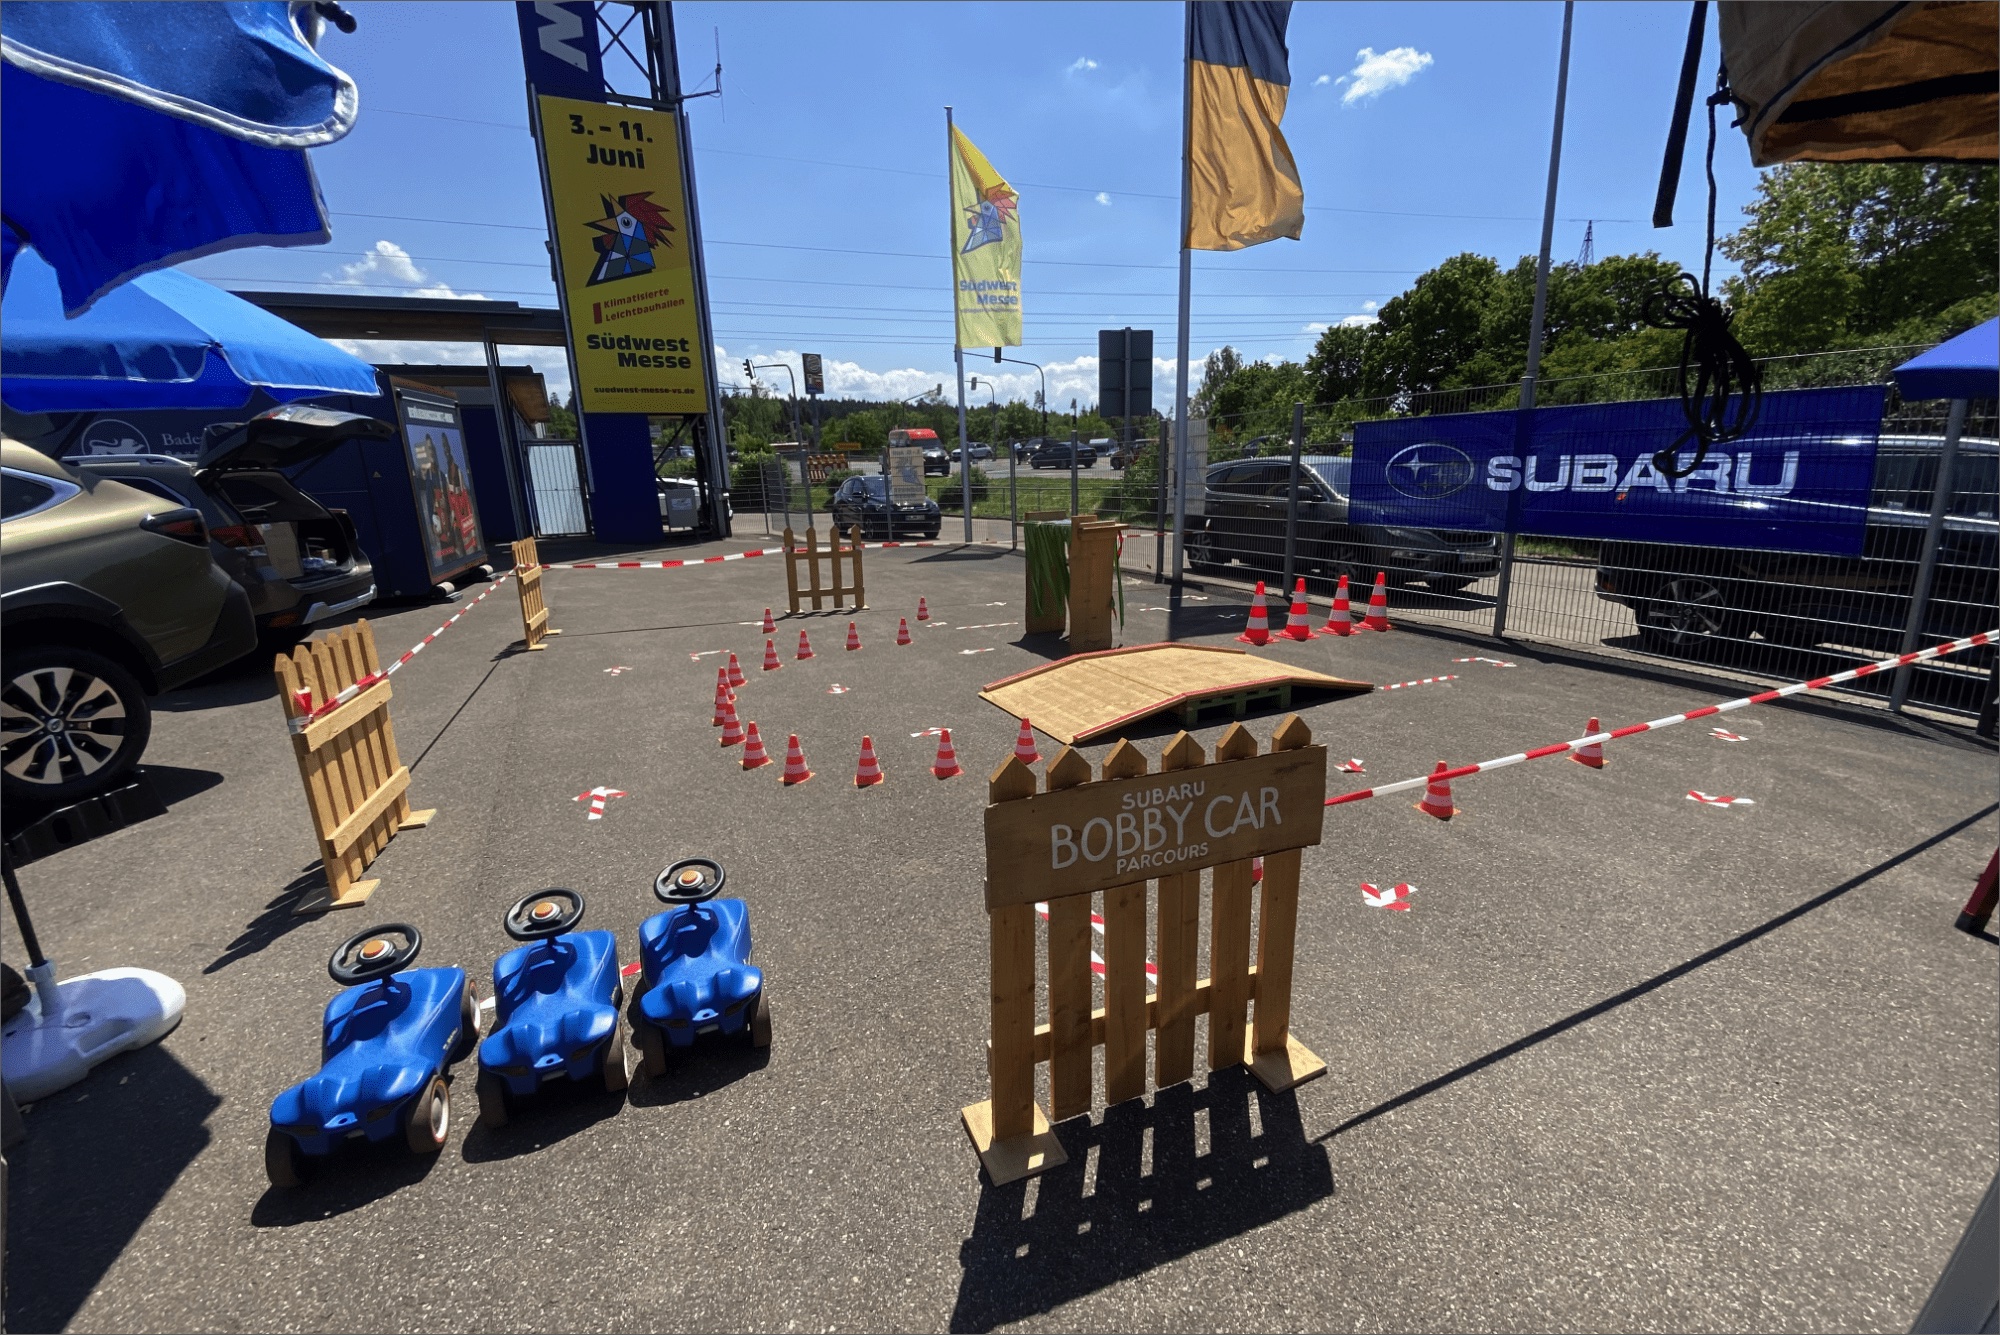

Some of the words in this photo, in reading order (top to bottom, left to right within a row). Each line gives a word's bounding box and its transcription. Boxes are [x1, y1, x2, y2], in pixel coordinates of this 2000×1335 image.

[619, 121, 653, 143] 11.
[587, 144, 645, 169] Juni
[603, 288, 669, 308] Klimatisierte
[977, 294, 1018, 305] Messe
[605, 298, 685, 322] Leichtbauhallen
[586, 332, 689, 352] Südwest
[617, 352, 691, 369] Messe
[593, 386, 695, 395] suedwest-messe-vs.de
[1486, 451, 1799, 496] SUBARU
[1121, 781, 1206, 810] SUBARU
[1051, 801, 1194, 870] BOBBY
[1204, 786, 1283, 838] CAR
[1116, 842, 1209, 874] PARCOURS
